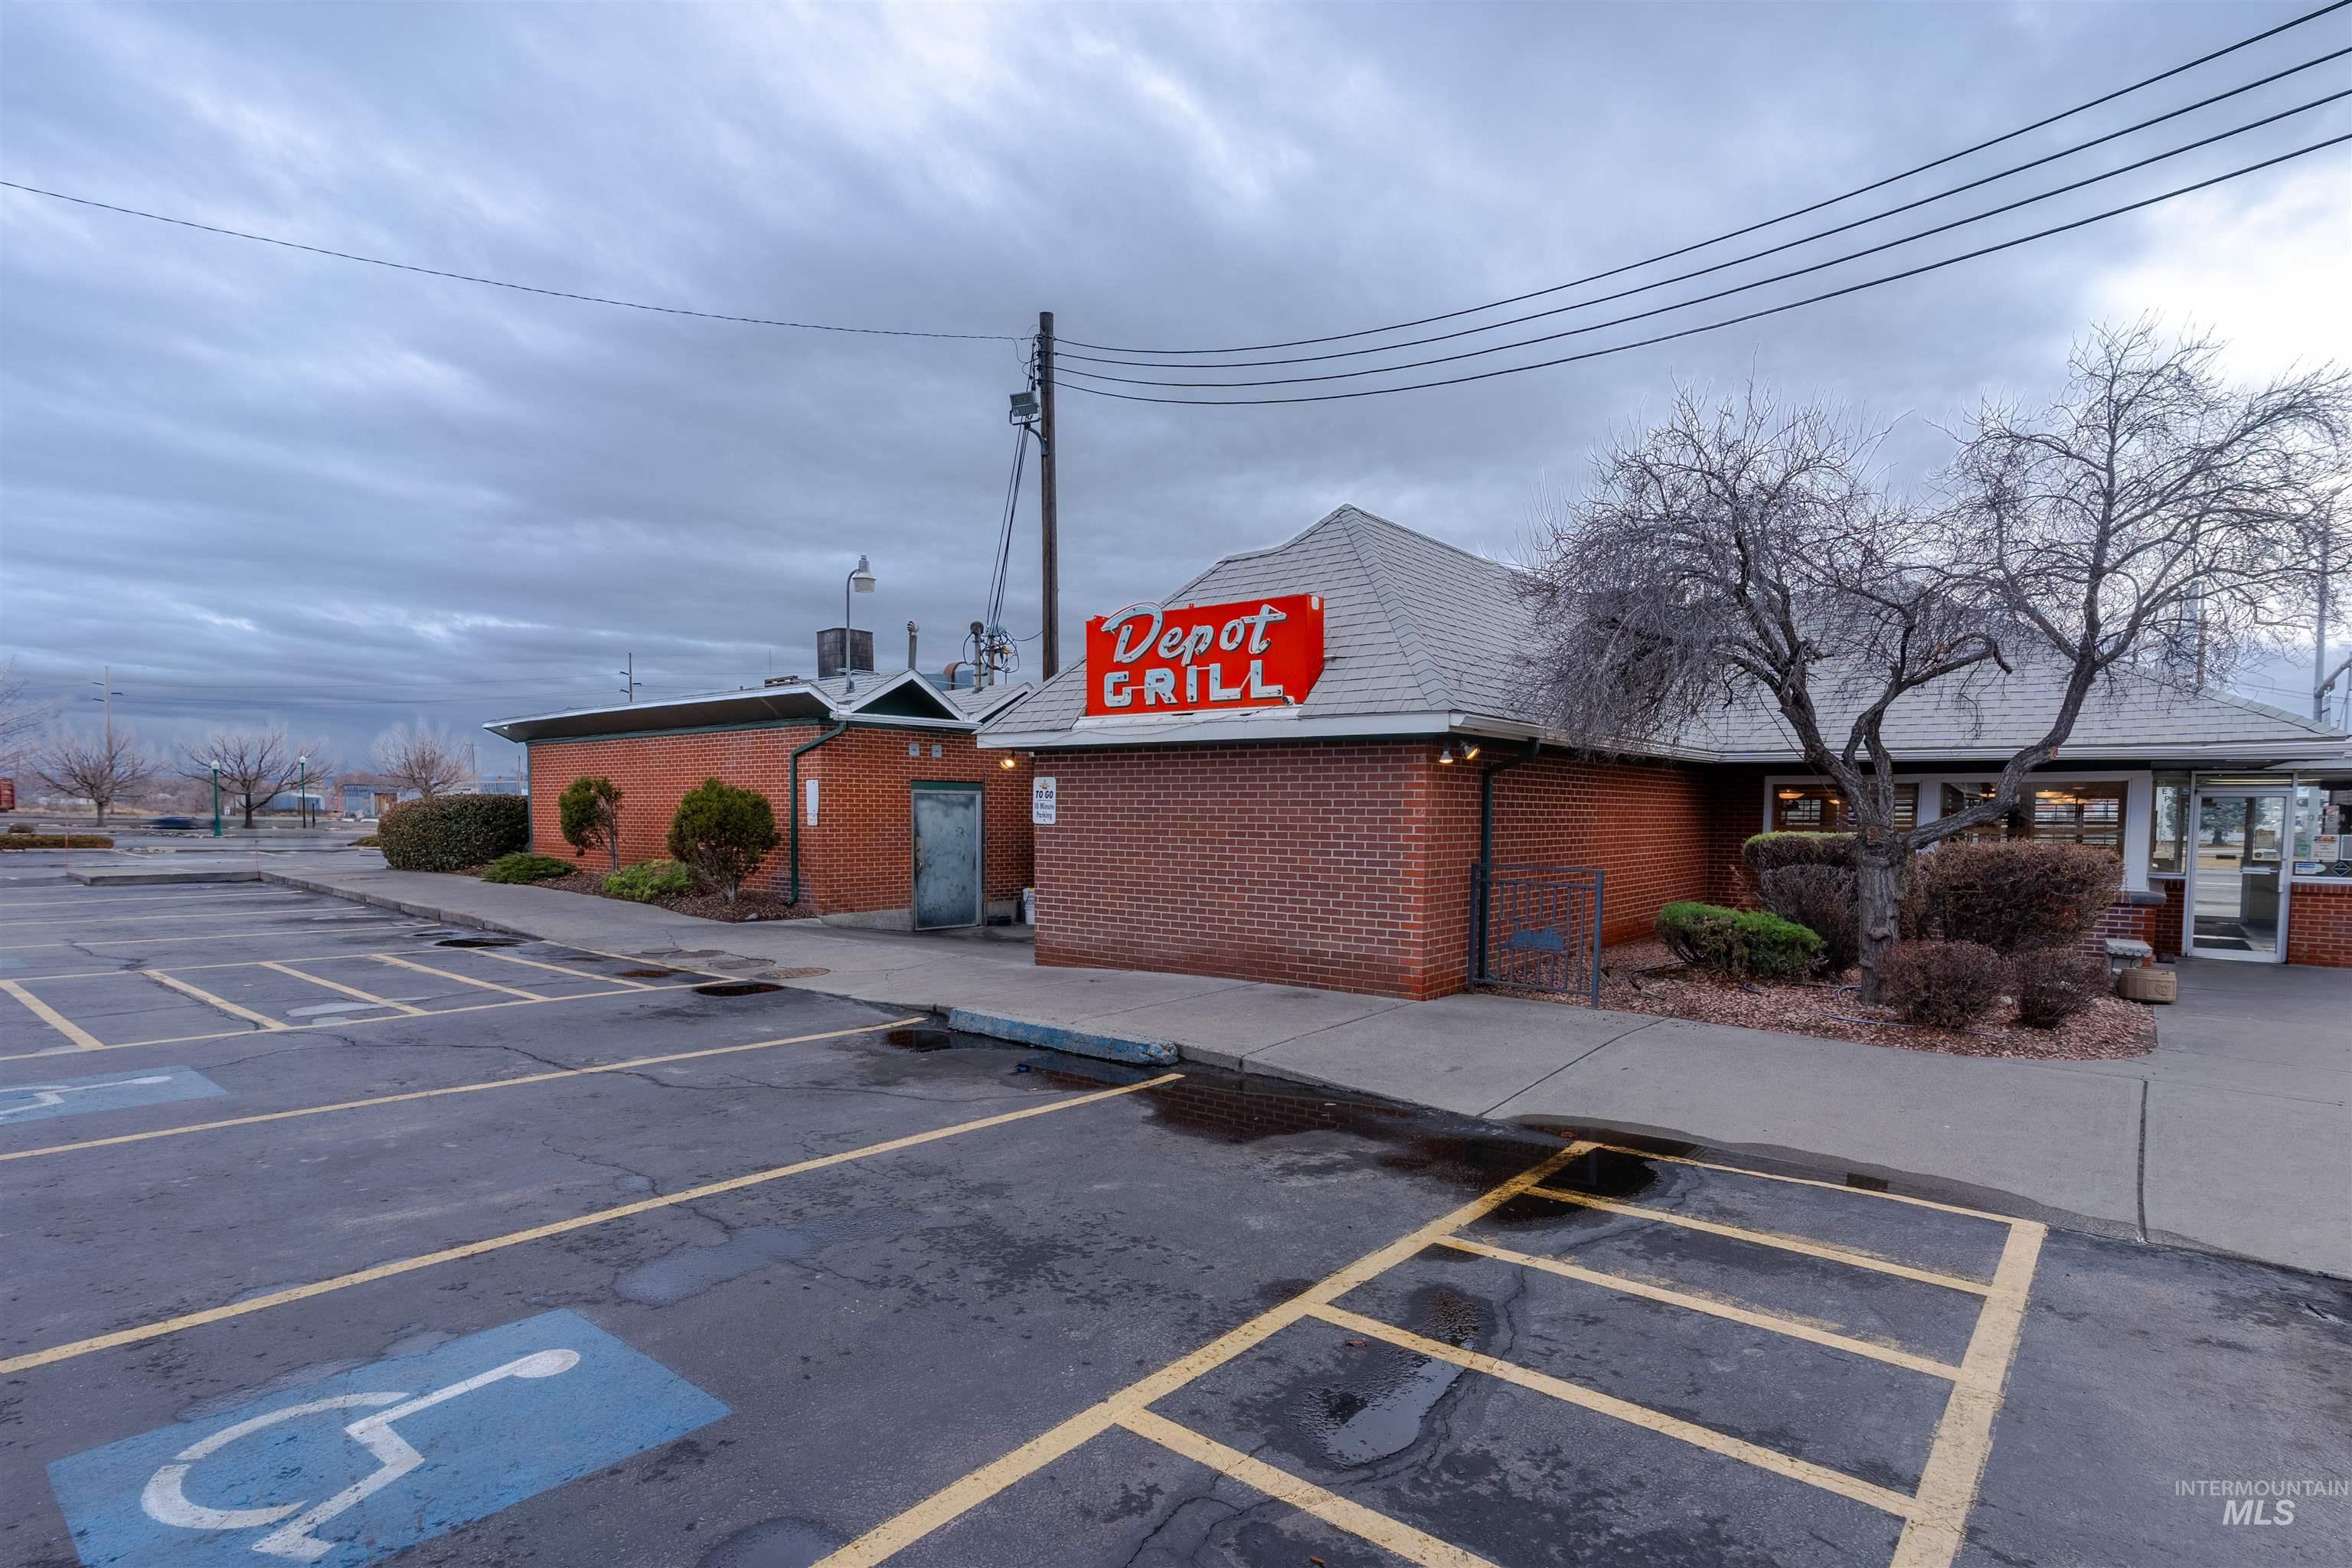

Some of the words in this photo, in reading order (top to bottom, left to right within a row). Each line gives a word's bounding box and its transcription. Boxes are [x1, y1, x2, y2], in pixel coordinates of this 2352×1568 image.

[1101, 602, 1287, 666] Depot
[1104, 659, 1283, 707] GRILL
[1035, 790, 1044, 799] TO
[1045, 790, 1054, 799] GO
[1036, 811, 1053, 820] Parking
